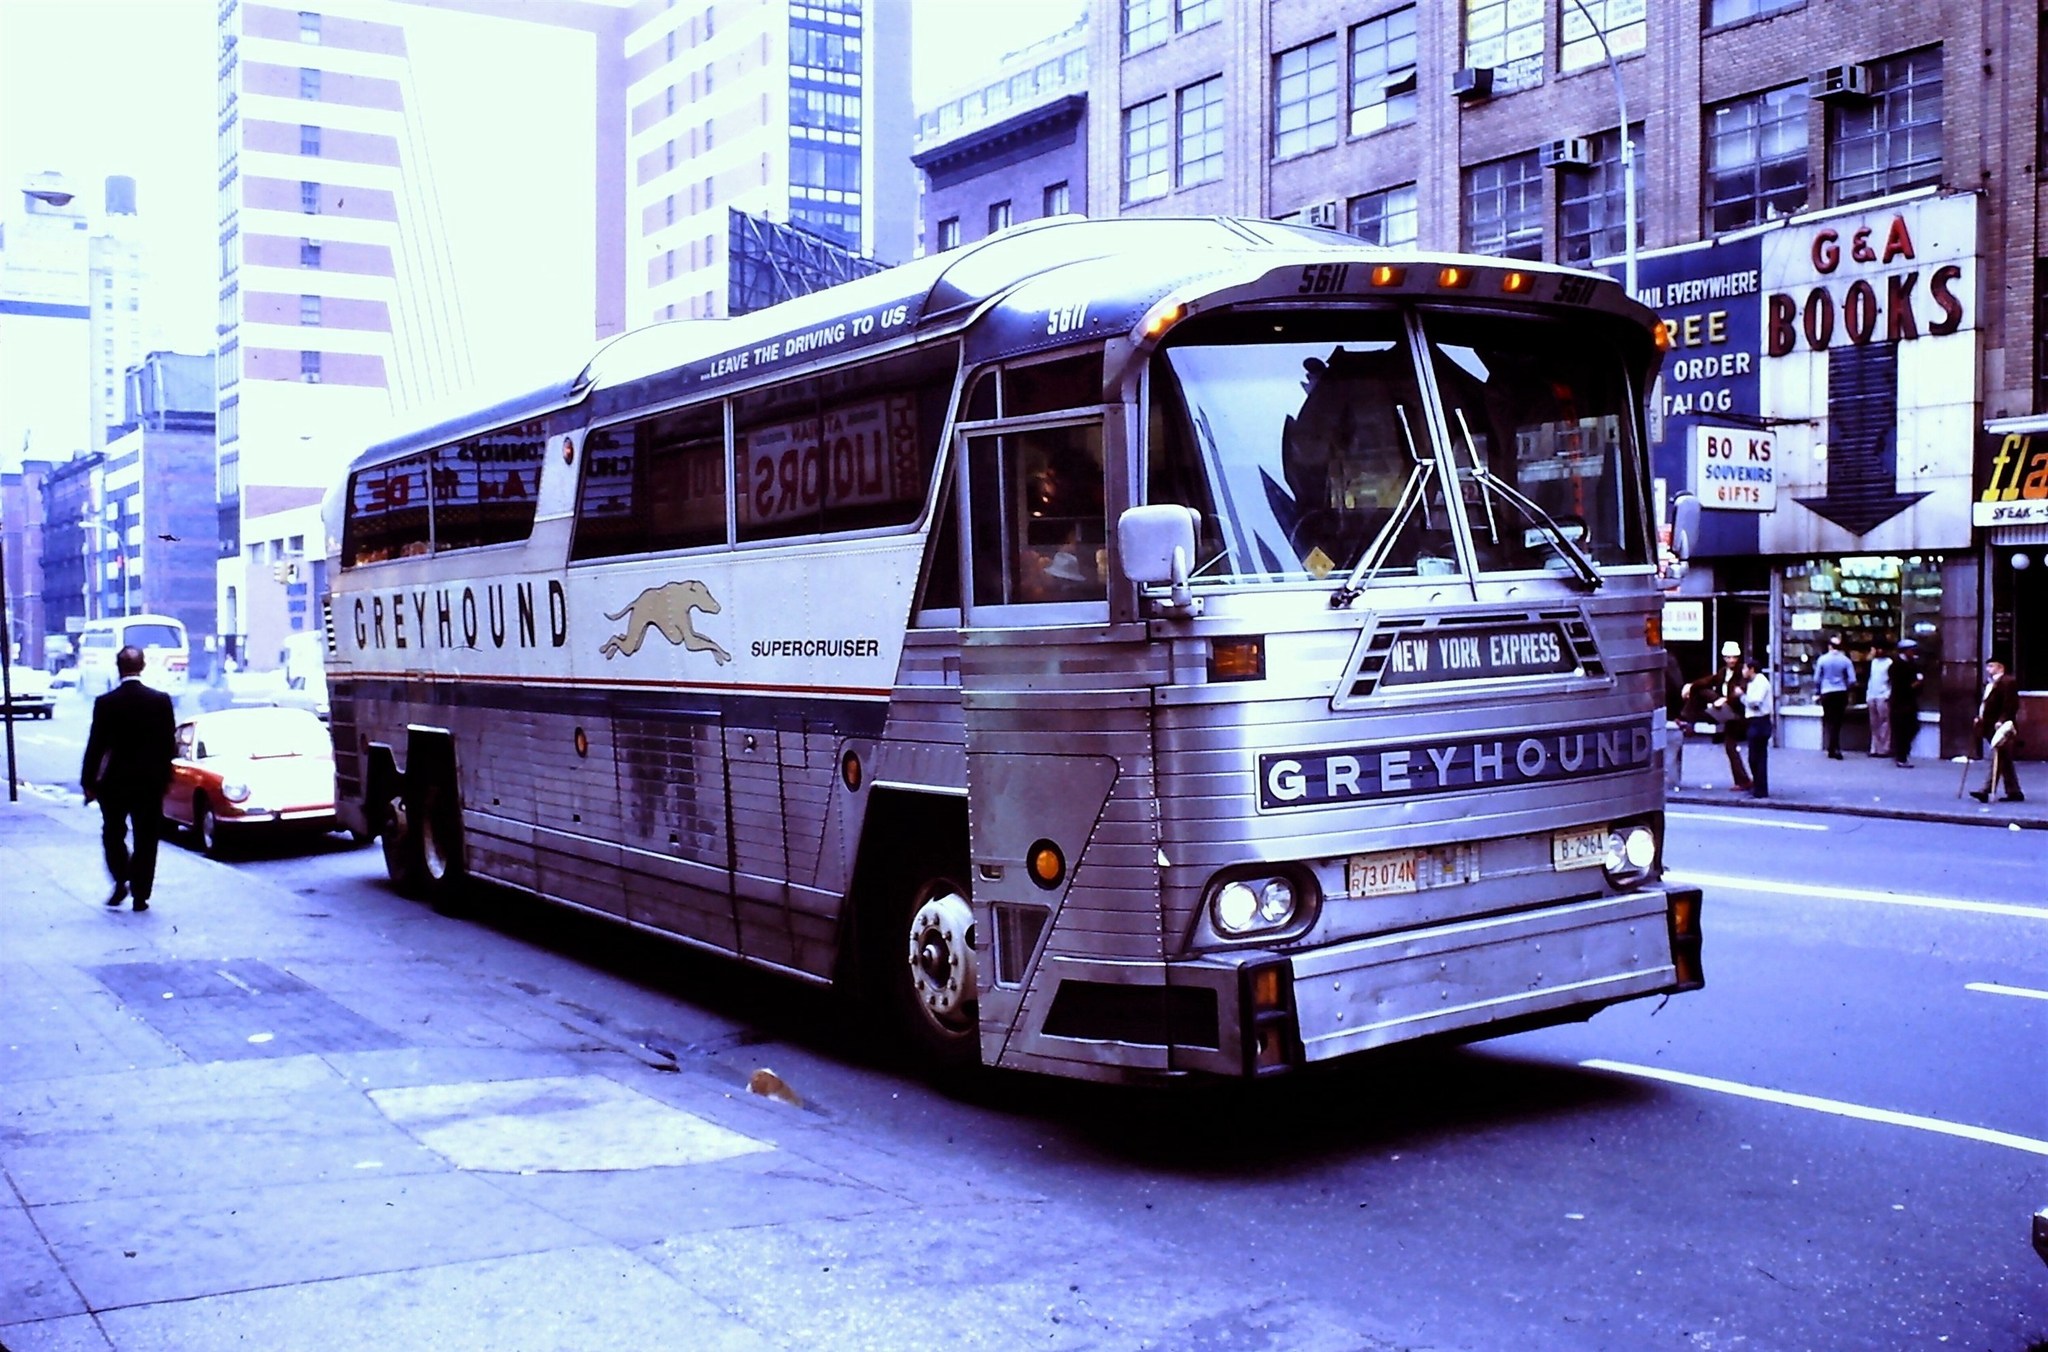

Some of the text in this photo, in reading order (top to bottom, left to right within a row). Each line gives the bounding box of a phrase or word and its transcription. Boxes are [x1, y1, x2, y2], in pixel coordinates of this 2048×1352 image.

[1298, 264, 1350, 294] 5611
[1553, 276, 1598, 305] 5611
[1667, 270, 1758, 306] EVERYWHERE
[1047, 302, 1090, 335] 5611
[1768, 265, 1963, 357] BOOKS
[754, 343, 780, 366] THE
[784, 323, 846, 357] DRIVING
[852, 315, 874, 337] TO
[880, 304, 907, 329] US
[1674, 352, 1750, 381] ORDER
[1705, 464, 1772, 483] SOUVENIRS
[1717, 486, 1760, 503] GIFTS
[1992, 506, 2031, 520] STEAK
[354, 579, 568, 650] GREYHOUND
[751, 639, 879, 657] SUPERCRUISER
[1392, 632, 1561, 673] NEW YORK EXPRESS
[1267, 727, 1651, 801] GREYHOUND
